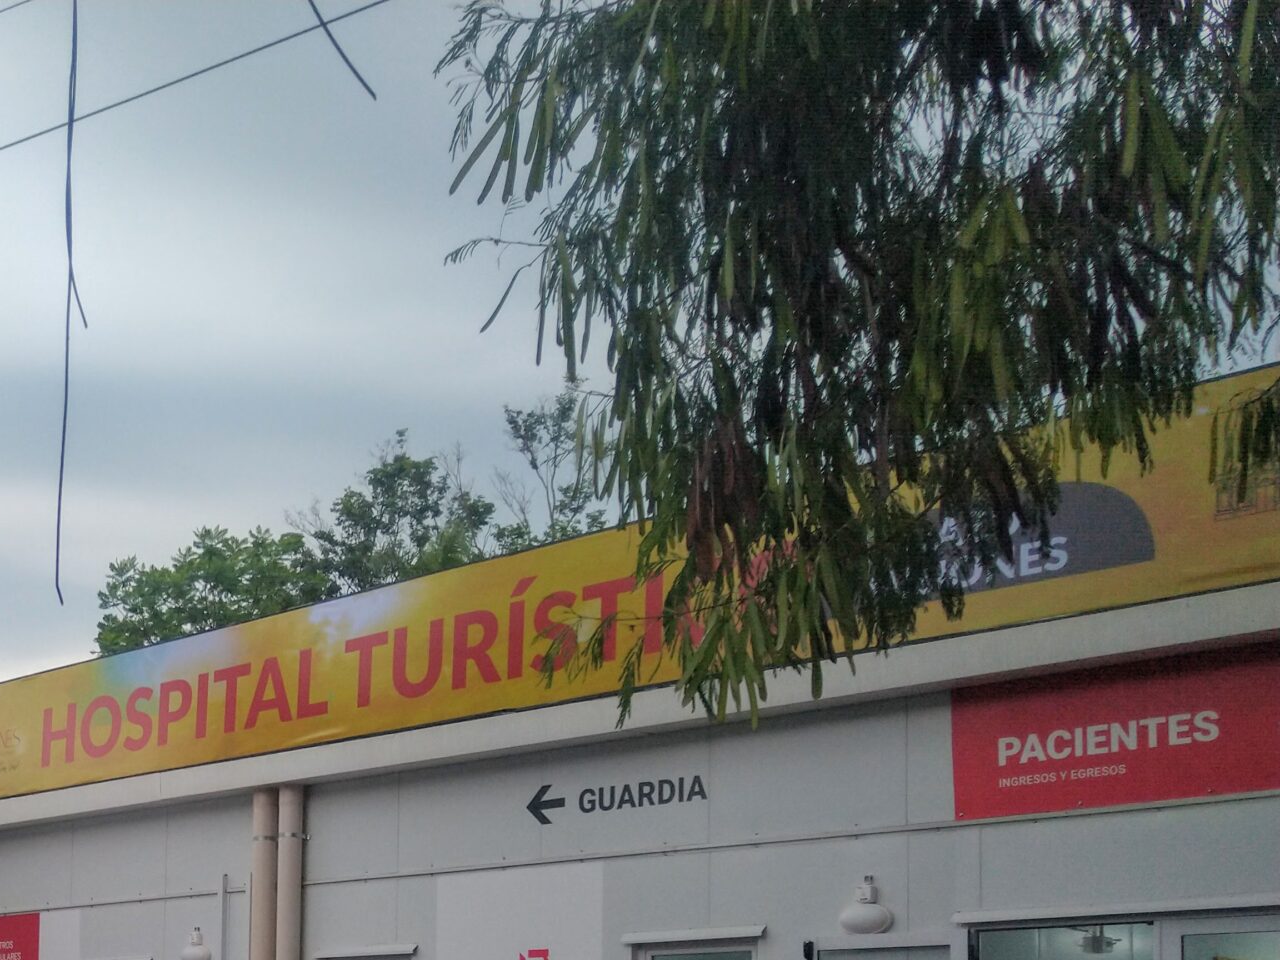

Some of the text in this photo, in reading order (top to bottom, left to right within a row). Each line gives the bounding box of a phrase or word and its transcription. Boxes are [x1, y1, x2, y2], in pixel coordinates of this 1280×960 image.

[41, 545, 805, 768] HOSPITAL TURÍSTI
[997, 710, 1220, 767] PACIENTES
[578, 775, 708, 813] GUARDIA
[998, 764, 1127, 788] INGRESOS Y EGRESOS
